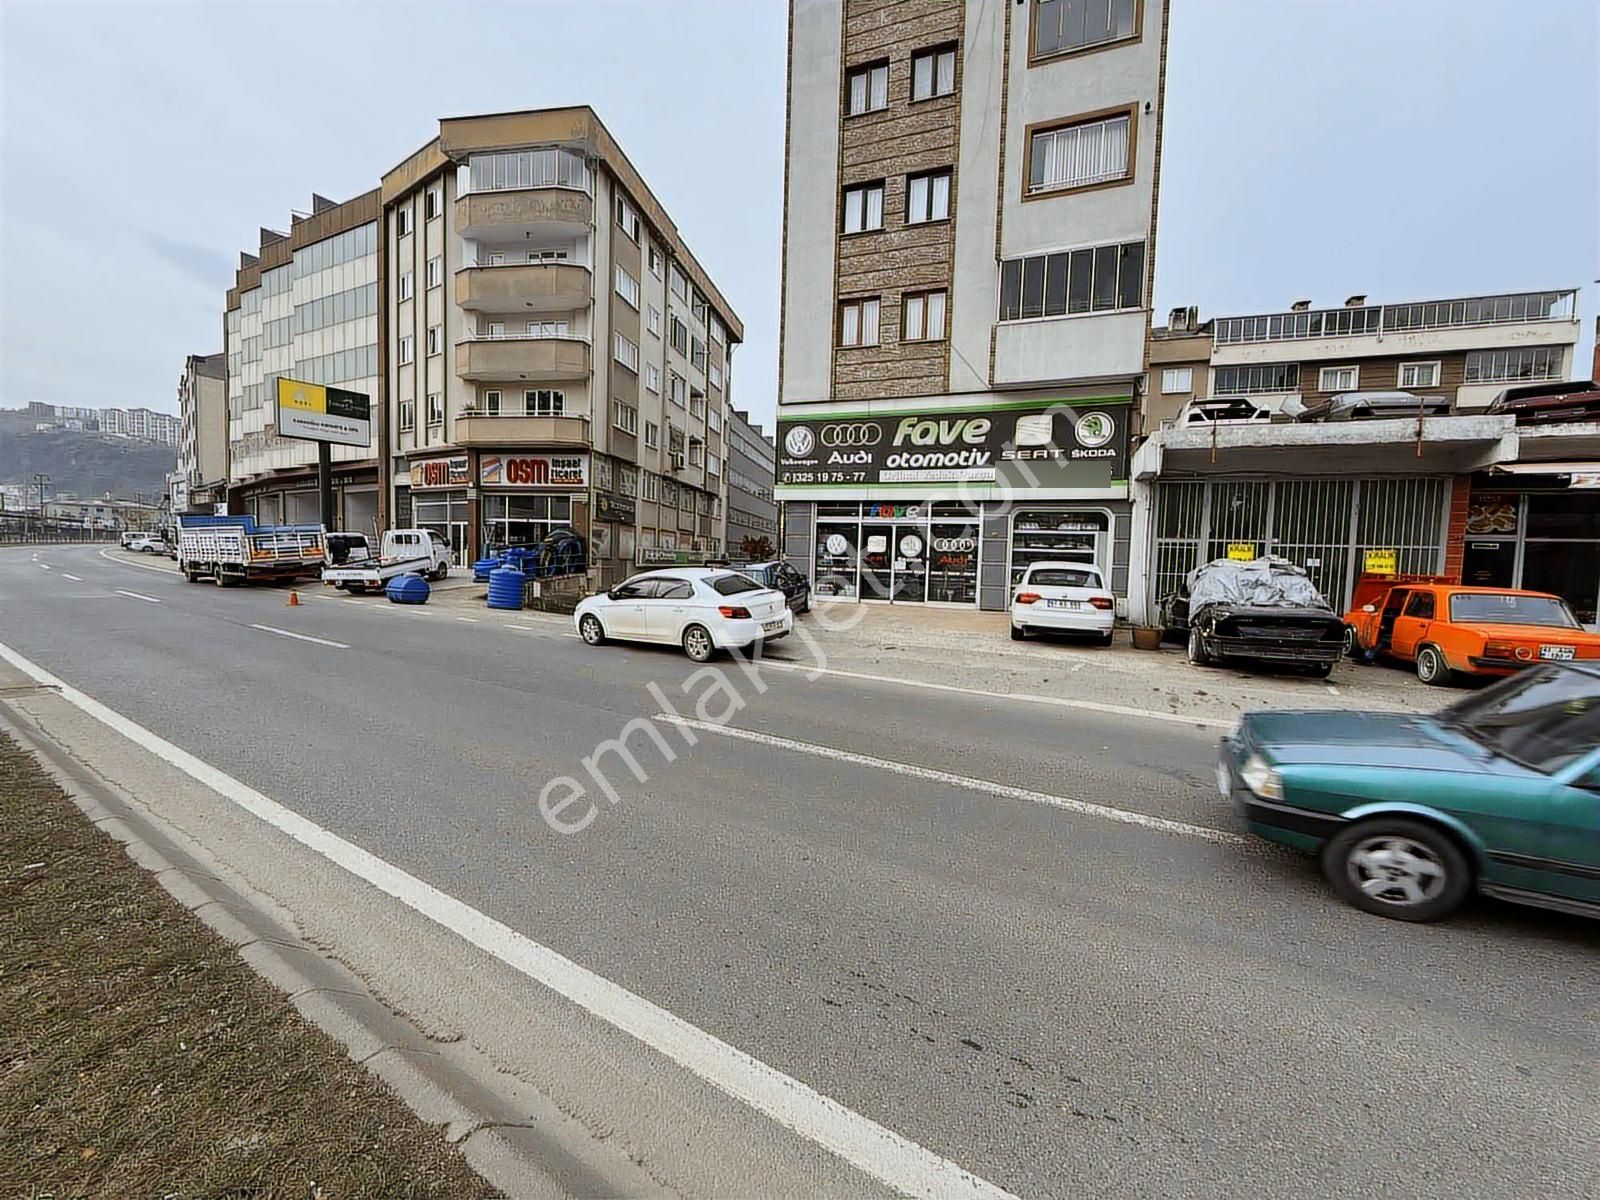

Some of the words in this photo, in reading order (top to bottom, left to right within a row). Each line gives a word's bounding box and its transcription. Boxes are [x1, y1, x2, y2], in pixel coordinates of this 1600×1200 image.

[827, 450, 872, 464] Audi
[886, 448, 991, 468] otomotiv
[1001, 449, 1065, 460] SEAT
[817, 472, 828, 482] 19
[831, 472, 844, 482] 75
[853, 471, 866, 482] 77
